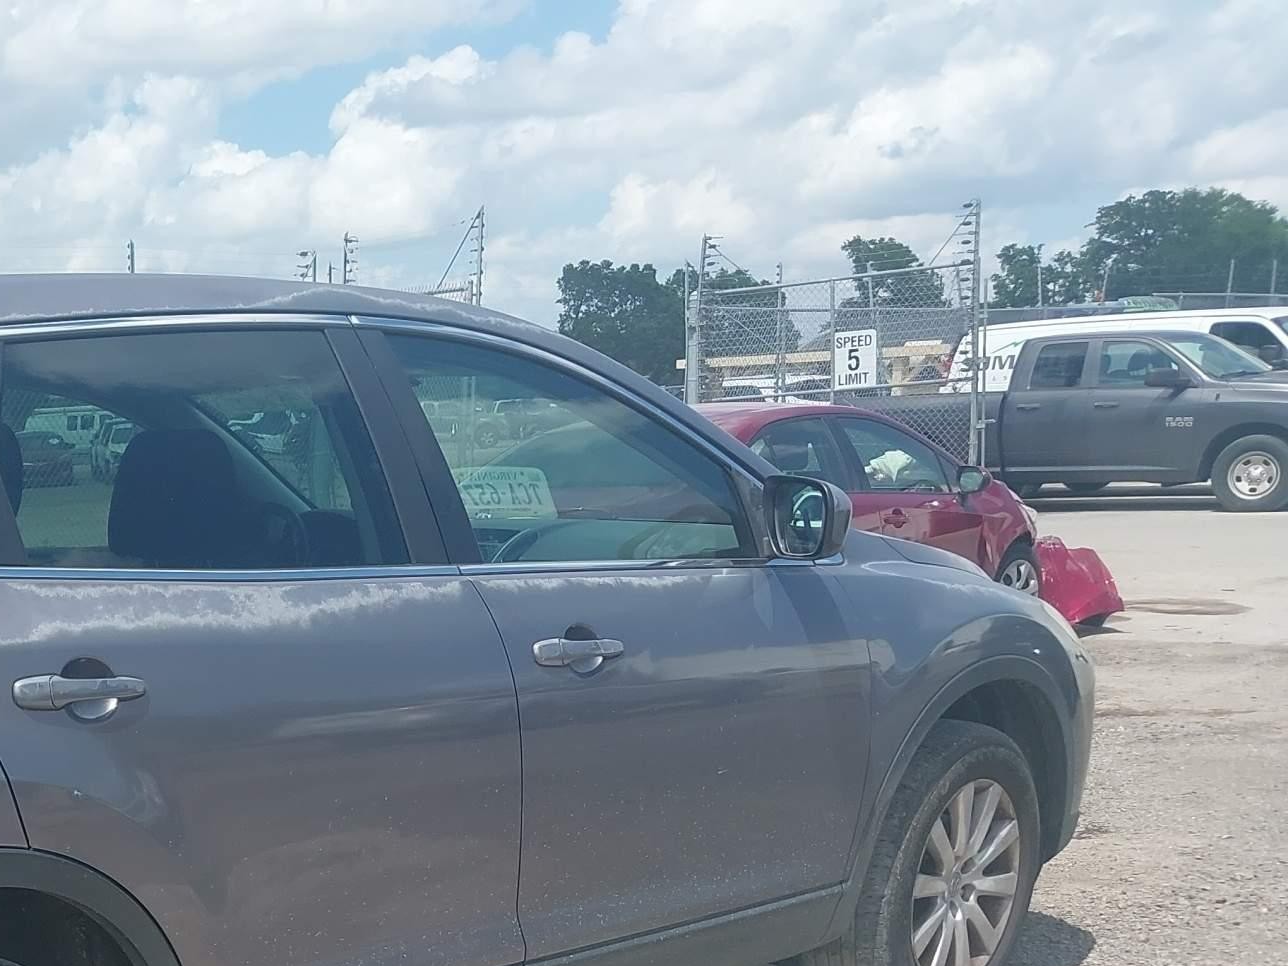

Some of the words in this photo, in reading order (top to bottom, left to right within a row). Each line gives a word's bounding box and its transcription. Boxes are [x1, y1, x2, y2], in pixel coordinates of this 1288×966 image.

[836, 334, 872, 349] SPEED
[848, 348, 860, 371] 5
[838, 371, 870, 386] LIMIT
